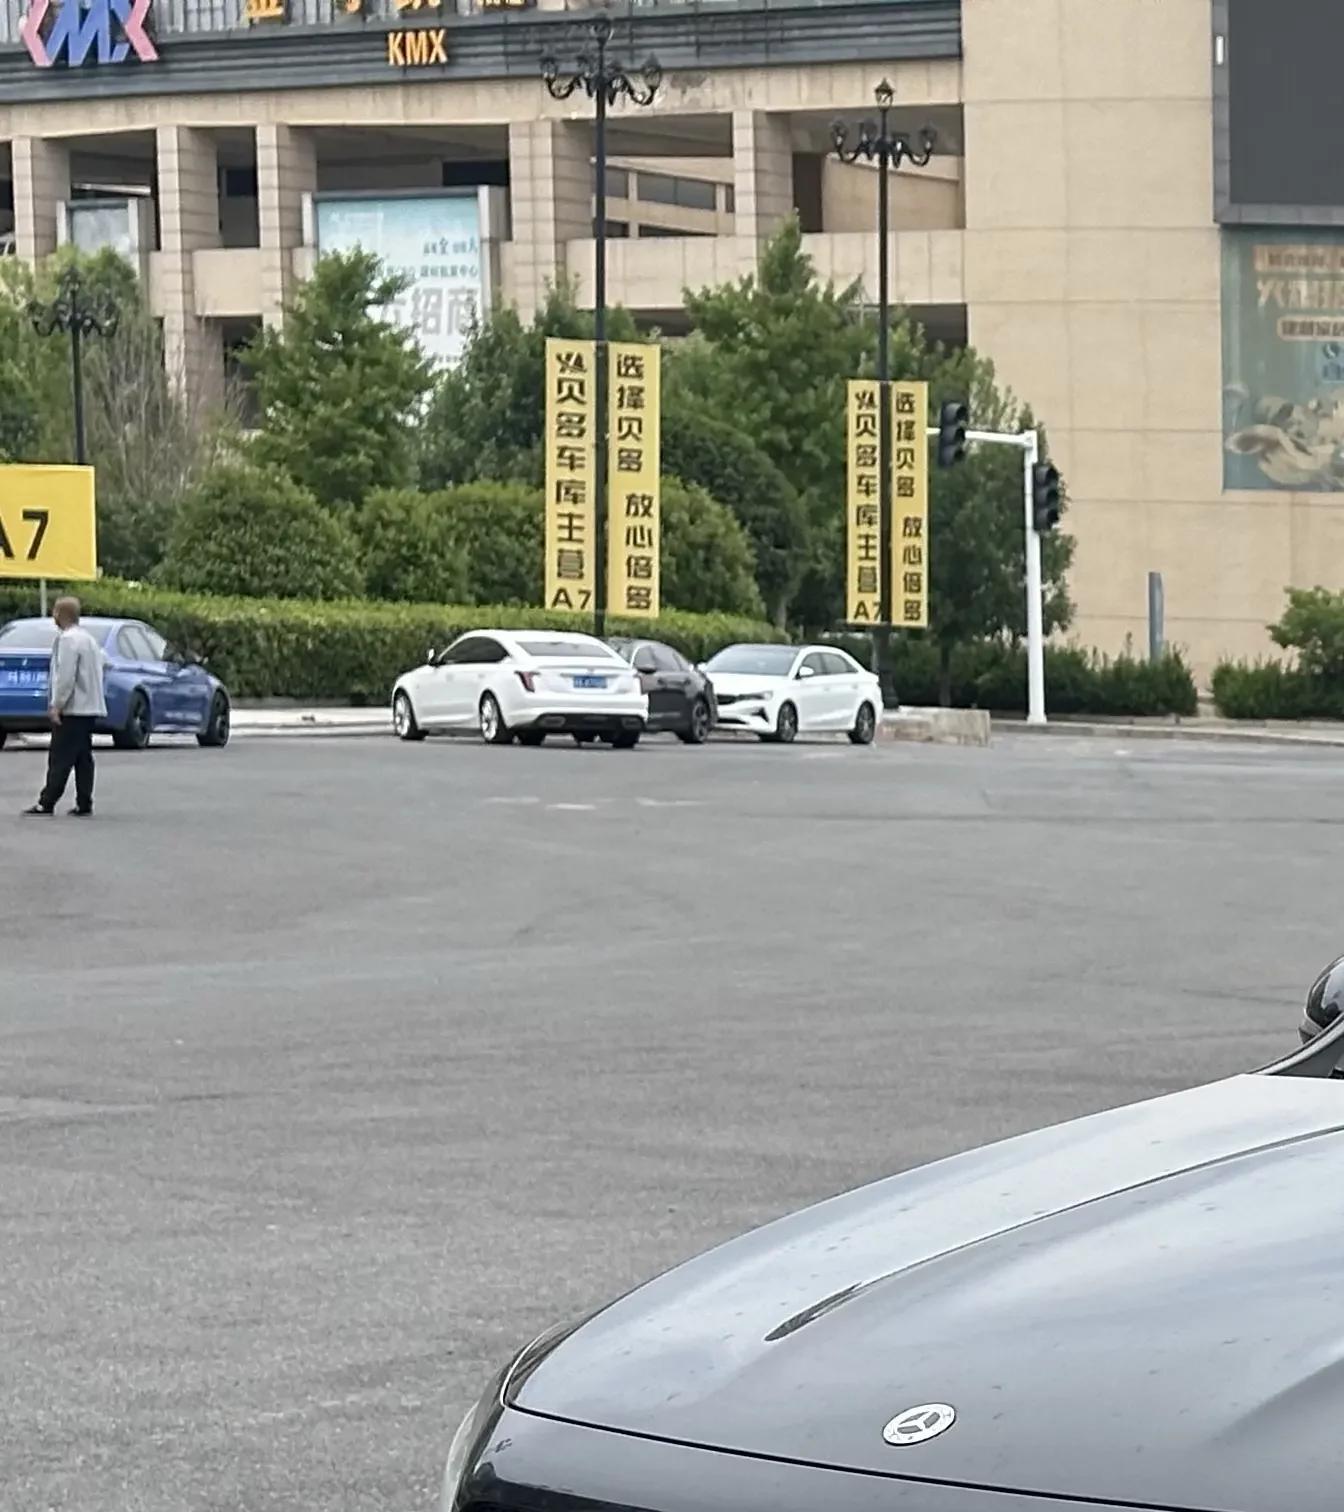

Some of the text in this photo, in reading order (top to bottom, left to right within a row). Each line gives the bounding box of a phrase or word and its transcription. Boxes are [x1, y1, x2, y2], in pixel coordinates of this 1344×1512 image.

[388, 29, 448, 65] KMX
[617, 353, 654, 610] 选择贝多 放心倍多
[895, 391, 923, 622] 选择贝多 放心倍多
[552, 588, 592, 610] A7
